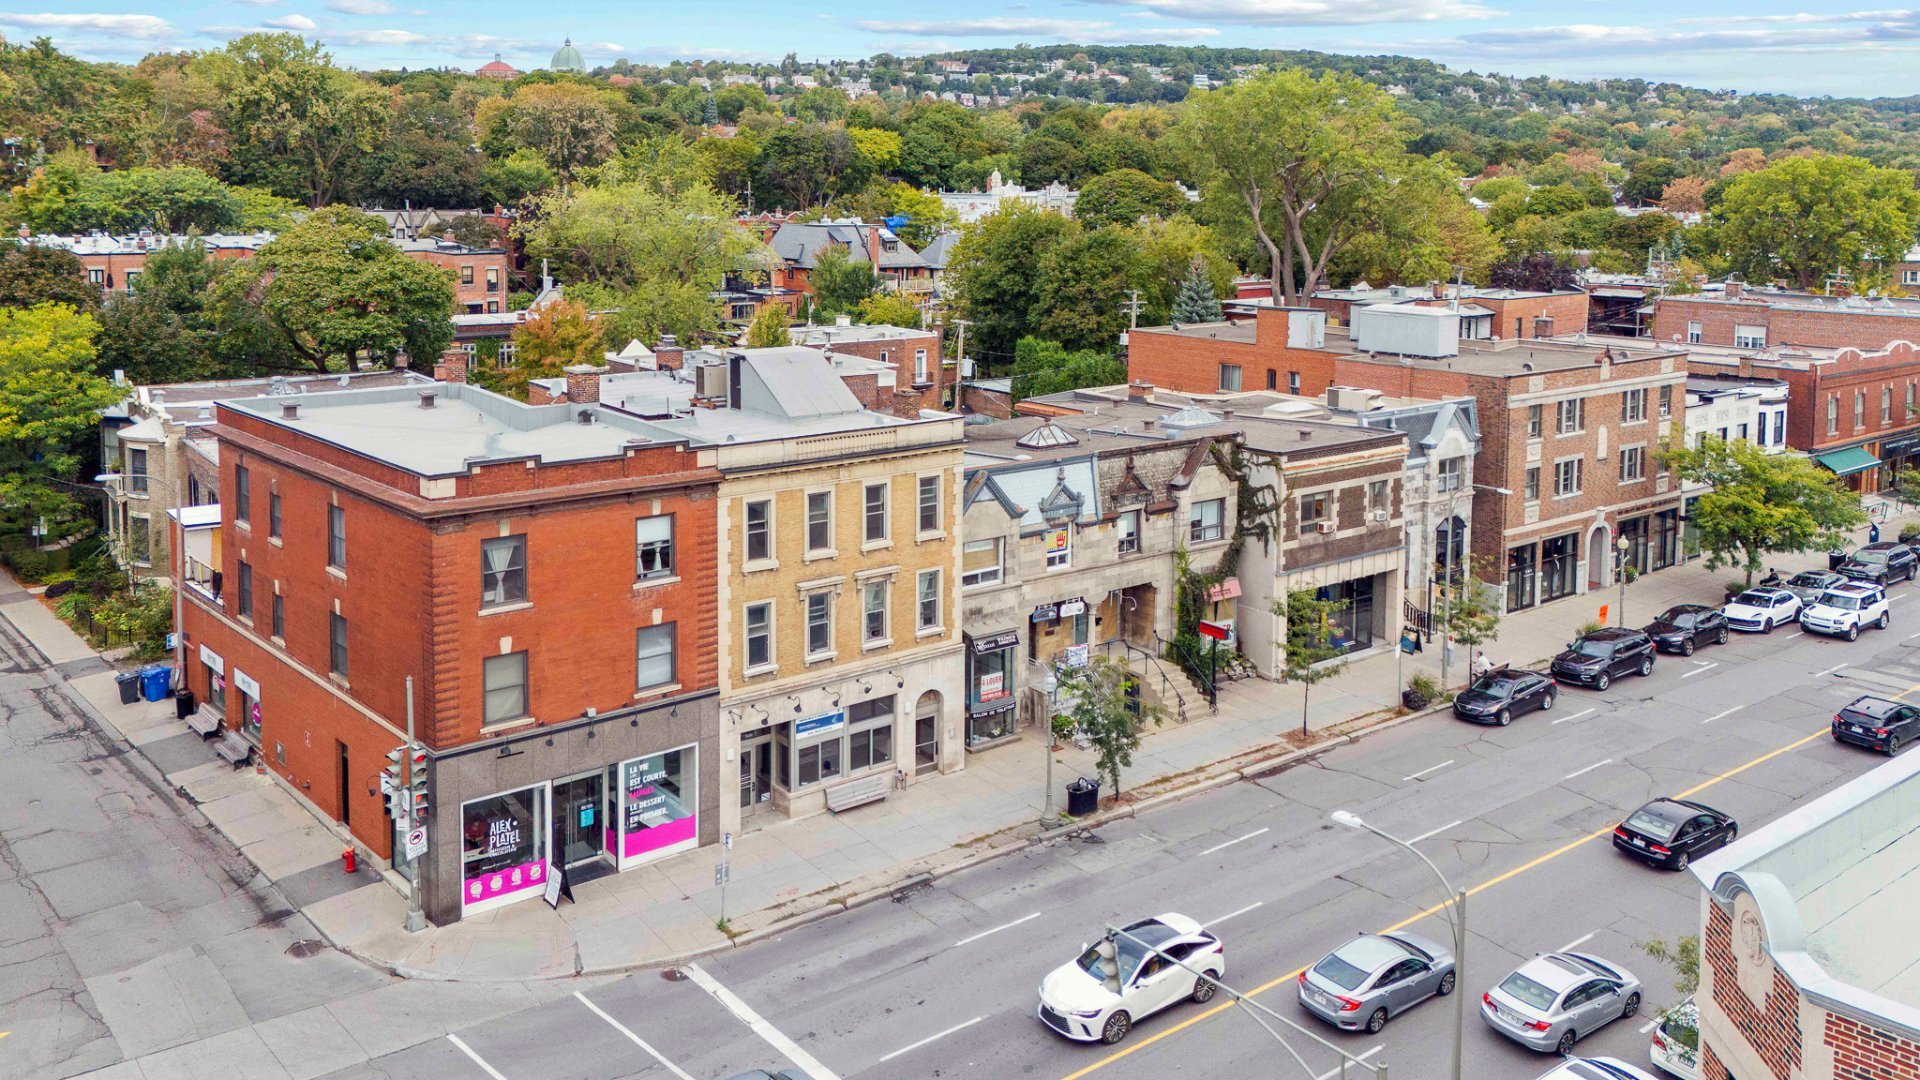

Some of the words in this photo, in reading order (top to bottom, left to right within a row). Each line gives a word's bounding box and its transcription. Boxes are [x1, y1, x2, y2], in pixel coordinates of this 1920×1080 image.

[973, 711, 988, 719] SALON
[630, 766, 638, 774] LA
[639, 763, 649, 772] VIE
[630, 777, 641, 787] EST
[630, 803, 638, 811] LE
[640, 795, 665, 809] DESSERT
[630, 815, 639, 824] EN
[490, 818, 511, 836] ALEX
[490, 830, 520, 848] PLATEL
